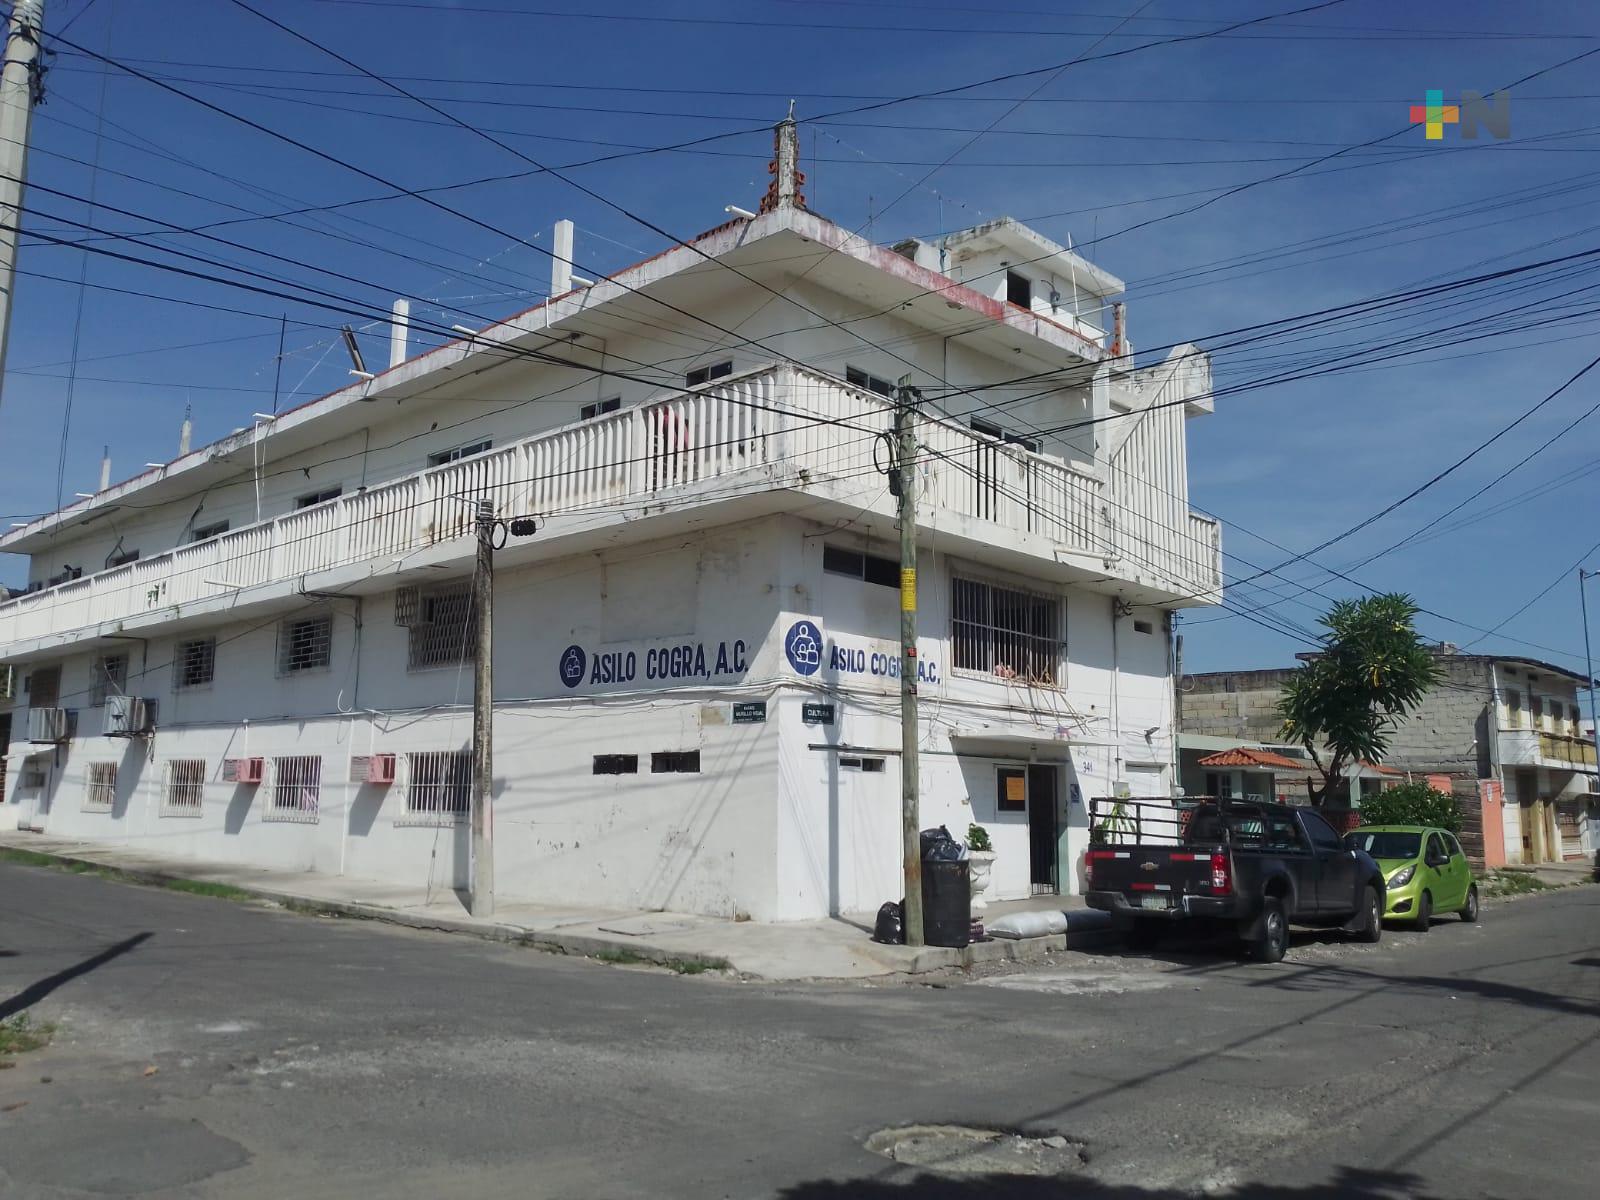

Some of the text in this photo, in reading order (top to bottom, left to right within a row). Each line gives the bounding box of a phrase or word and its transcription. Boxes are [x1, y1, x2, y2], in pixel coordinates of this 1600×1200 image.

[590, 640, 749, 684] ASILO COGRA, A.C.
[830, 646, 865, 673] ASILO
